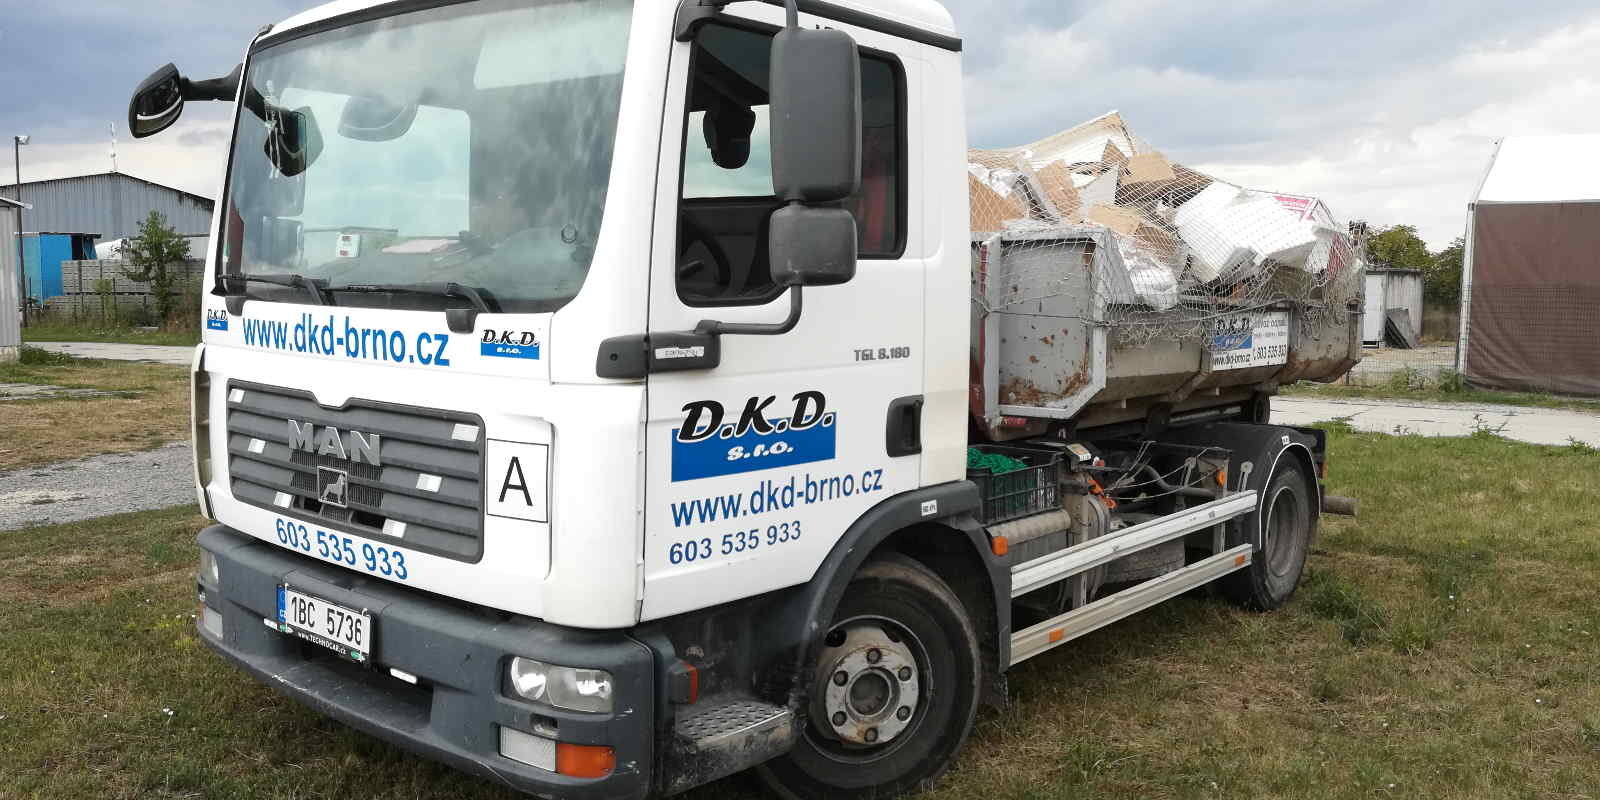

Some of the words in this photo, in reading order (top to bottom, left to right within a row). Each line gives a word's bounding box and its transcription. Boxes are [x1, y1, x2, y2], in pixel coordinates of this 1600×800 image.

[242, 312, 450, 366] www.dkd-brno.cz
[483, 329, 539, 346] D.K.D.
[854, 349, 876, 361] TGL
[878, 346, 910, 359] 8.180
[678, 390, 834, 442] D.K.D.
[288, 419, 381, 466] MAN
[727, 441, 793, 461] s.r.o.
[499, 456, 533, 506] A
[671, 468, 883, 527] www.dkd-brno.cz
[276, 518, 311, 552] 603
[317, 530, 356, 566] 535
[362, 543, 408, 580] 933
[669, 538, 712, 564] 603
[721, 529, 759, 555] 535
[767, 520, 801, 546] 933
[291, 596, 316, 628] 1BC
[326, 608, 363, 646] 5736
